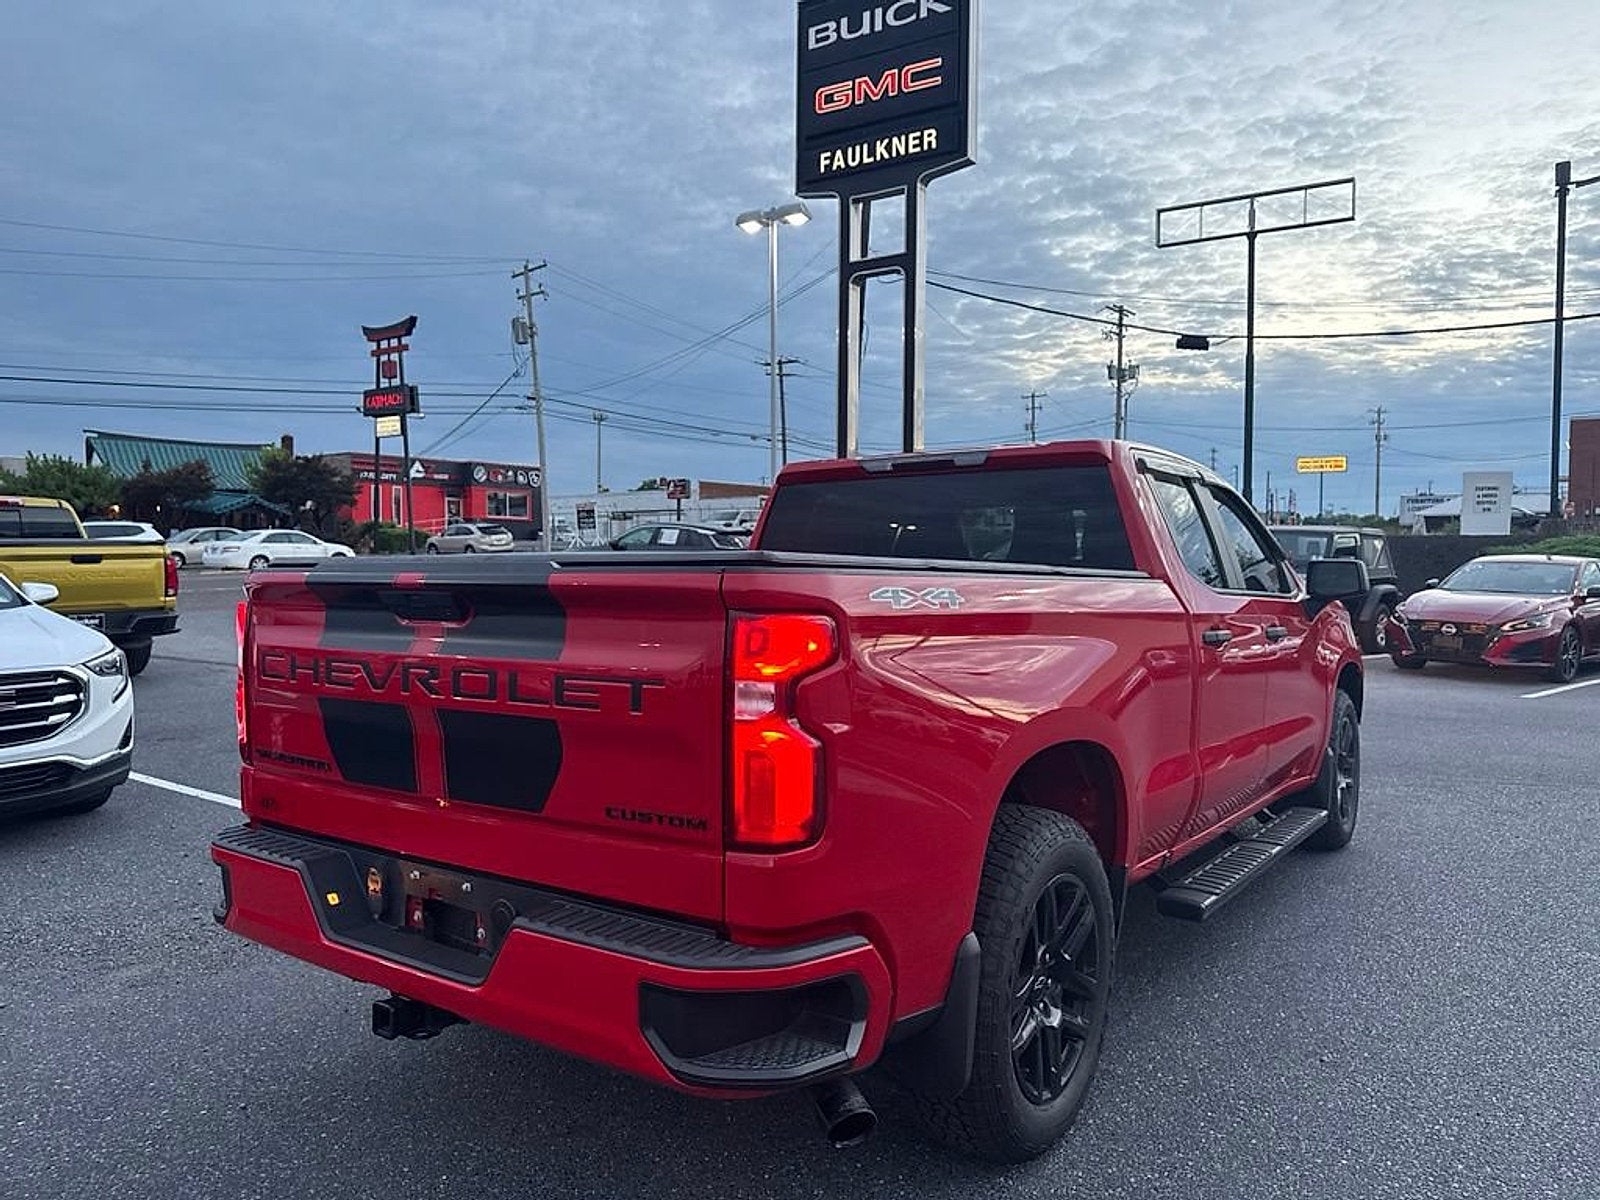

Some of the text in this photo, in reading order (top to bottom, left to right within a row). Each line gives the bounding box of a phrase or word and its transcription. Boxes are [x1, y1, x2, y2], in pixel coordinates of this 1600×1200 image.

[807, 0, 952, 50] BUICK
[815, 57, 942, 114] GMC
[819, 128, 938, 174] FAULKNER
[257, 650, 666, 715] CHEVROLET
[605, 806, 708, 831] CUSTOM
